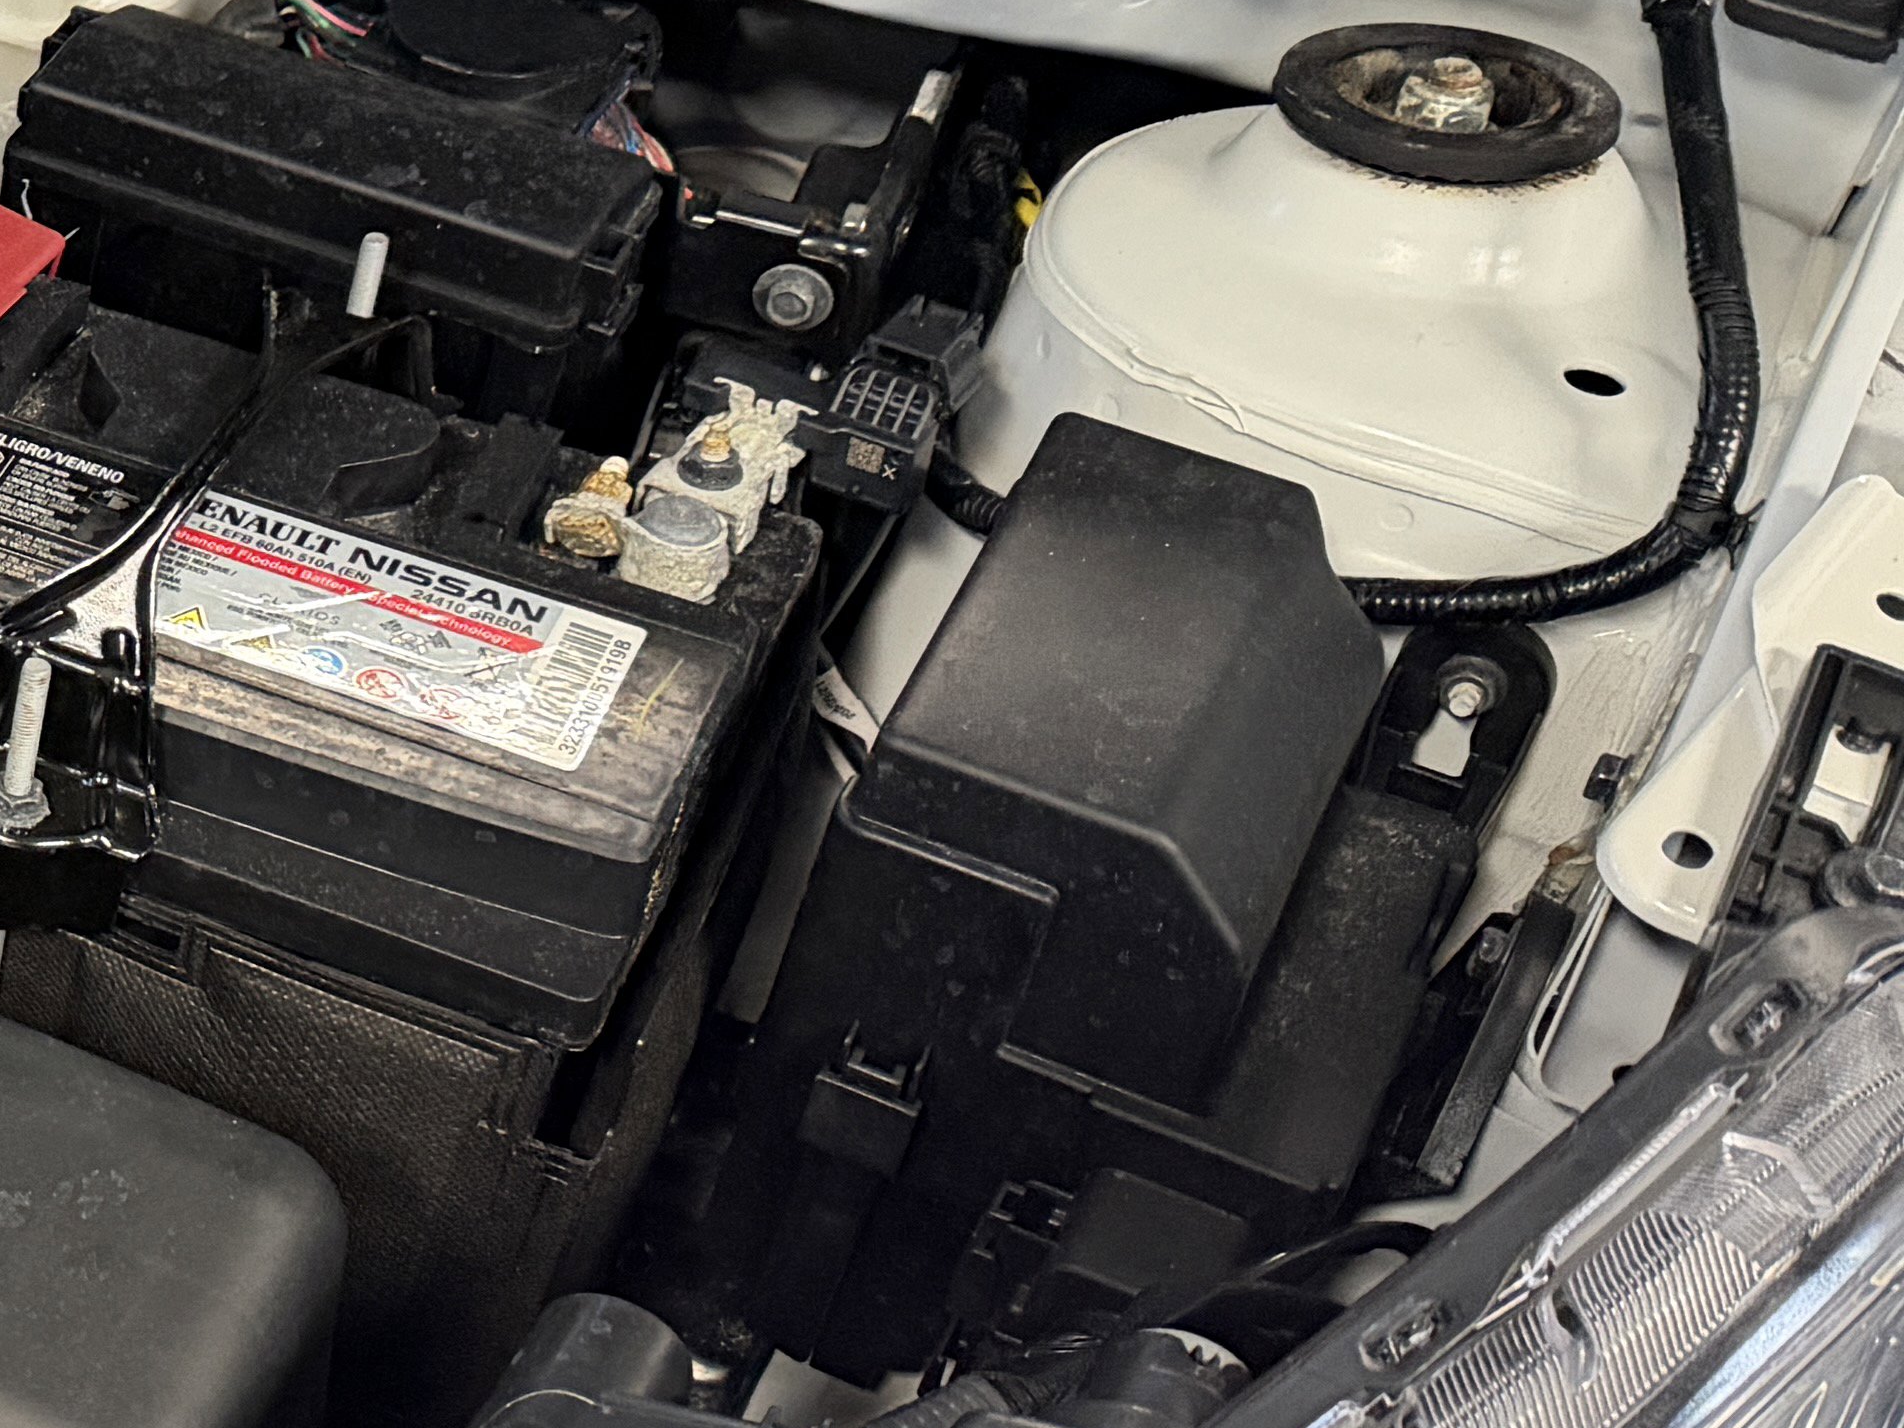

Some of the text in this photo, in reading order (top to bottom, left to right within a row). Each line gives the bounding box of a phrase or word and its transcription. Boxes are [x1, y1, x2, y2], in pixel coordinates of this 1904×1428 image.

[174, 527, 236, 556] hanced
[424, 609, 512, 647] chnology
[195, 496, 341, 558] ENAULT
[347, 545, 548, 623] NISSAN
[337, 564, 373, 585] (EN)
